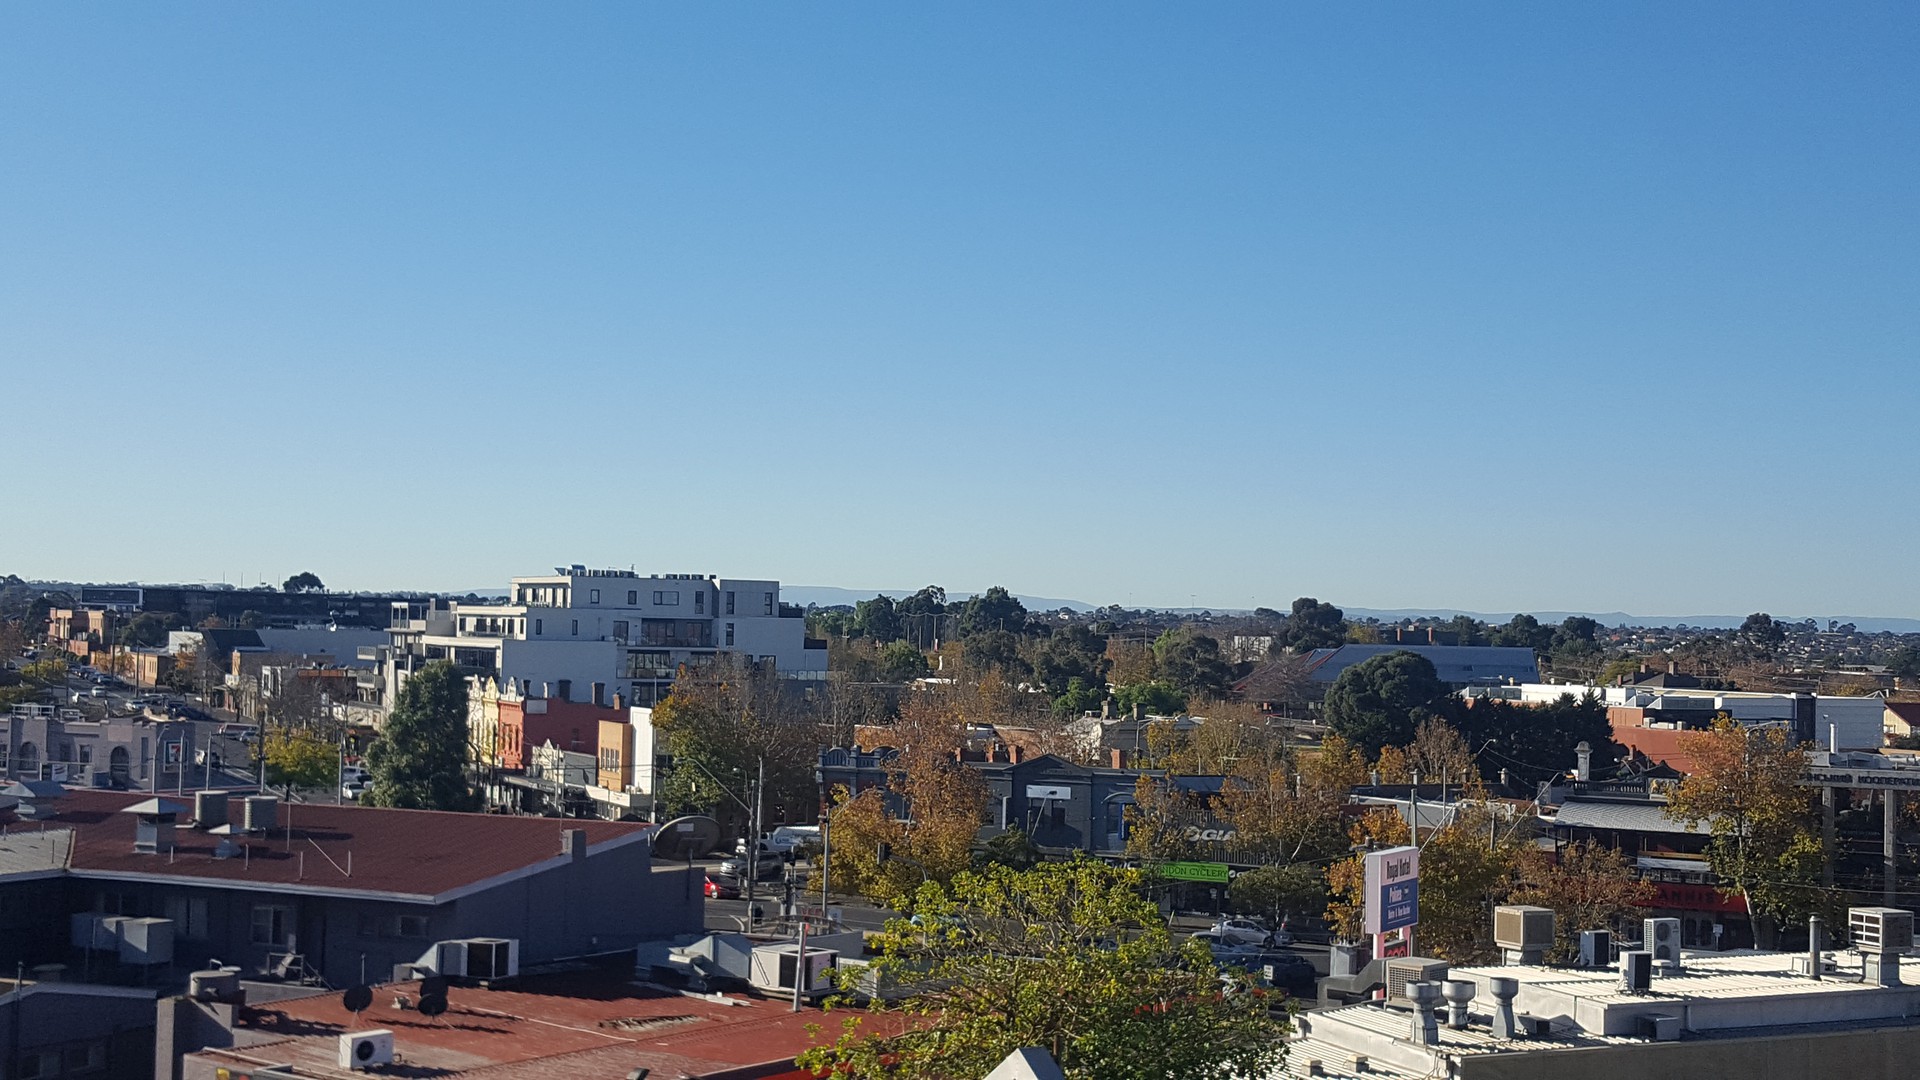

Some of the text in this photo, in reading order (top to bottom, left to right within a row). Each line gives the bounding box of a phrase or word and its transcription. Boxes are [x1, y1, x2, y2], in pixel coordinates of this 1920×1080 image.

[1200, 829, 1237, 841] GIA
[1161, 866, 1187, 875] NDON
[1189, 867, 1228, 878] CYCLERY
[1387, 856, 1411, 881] Royal Hotel
